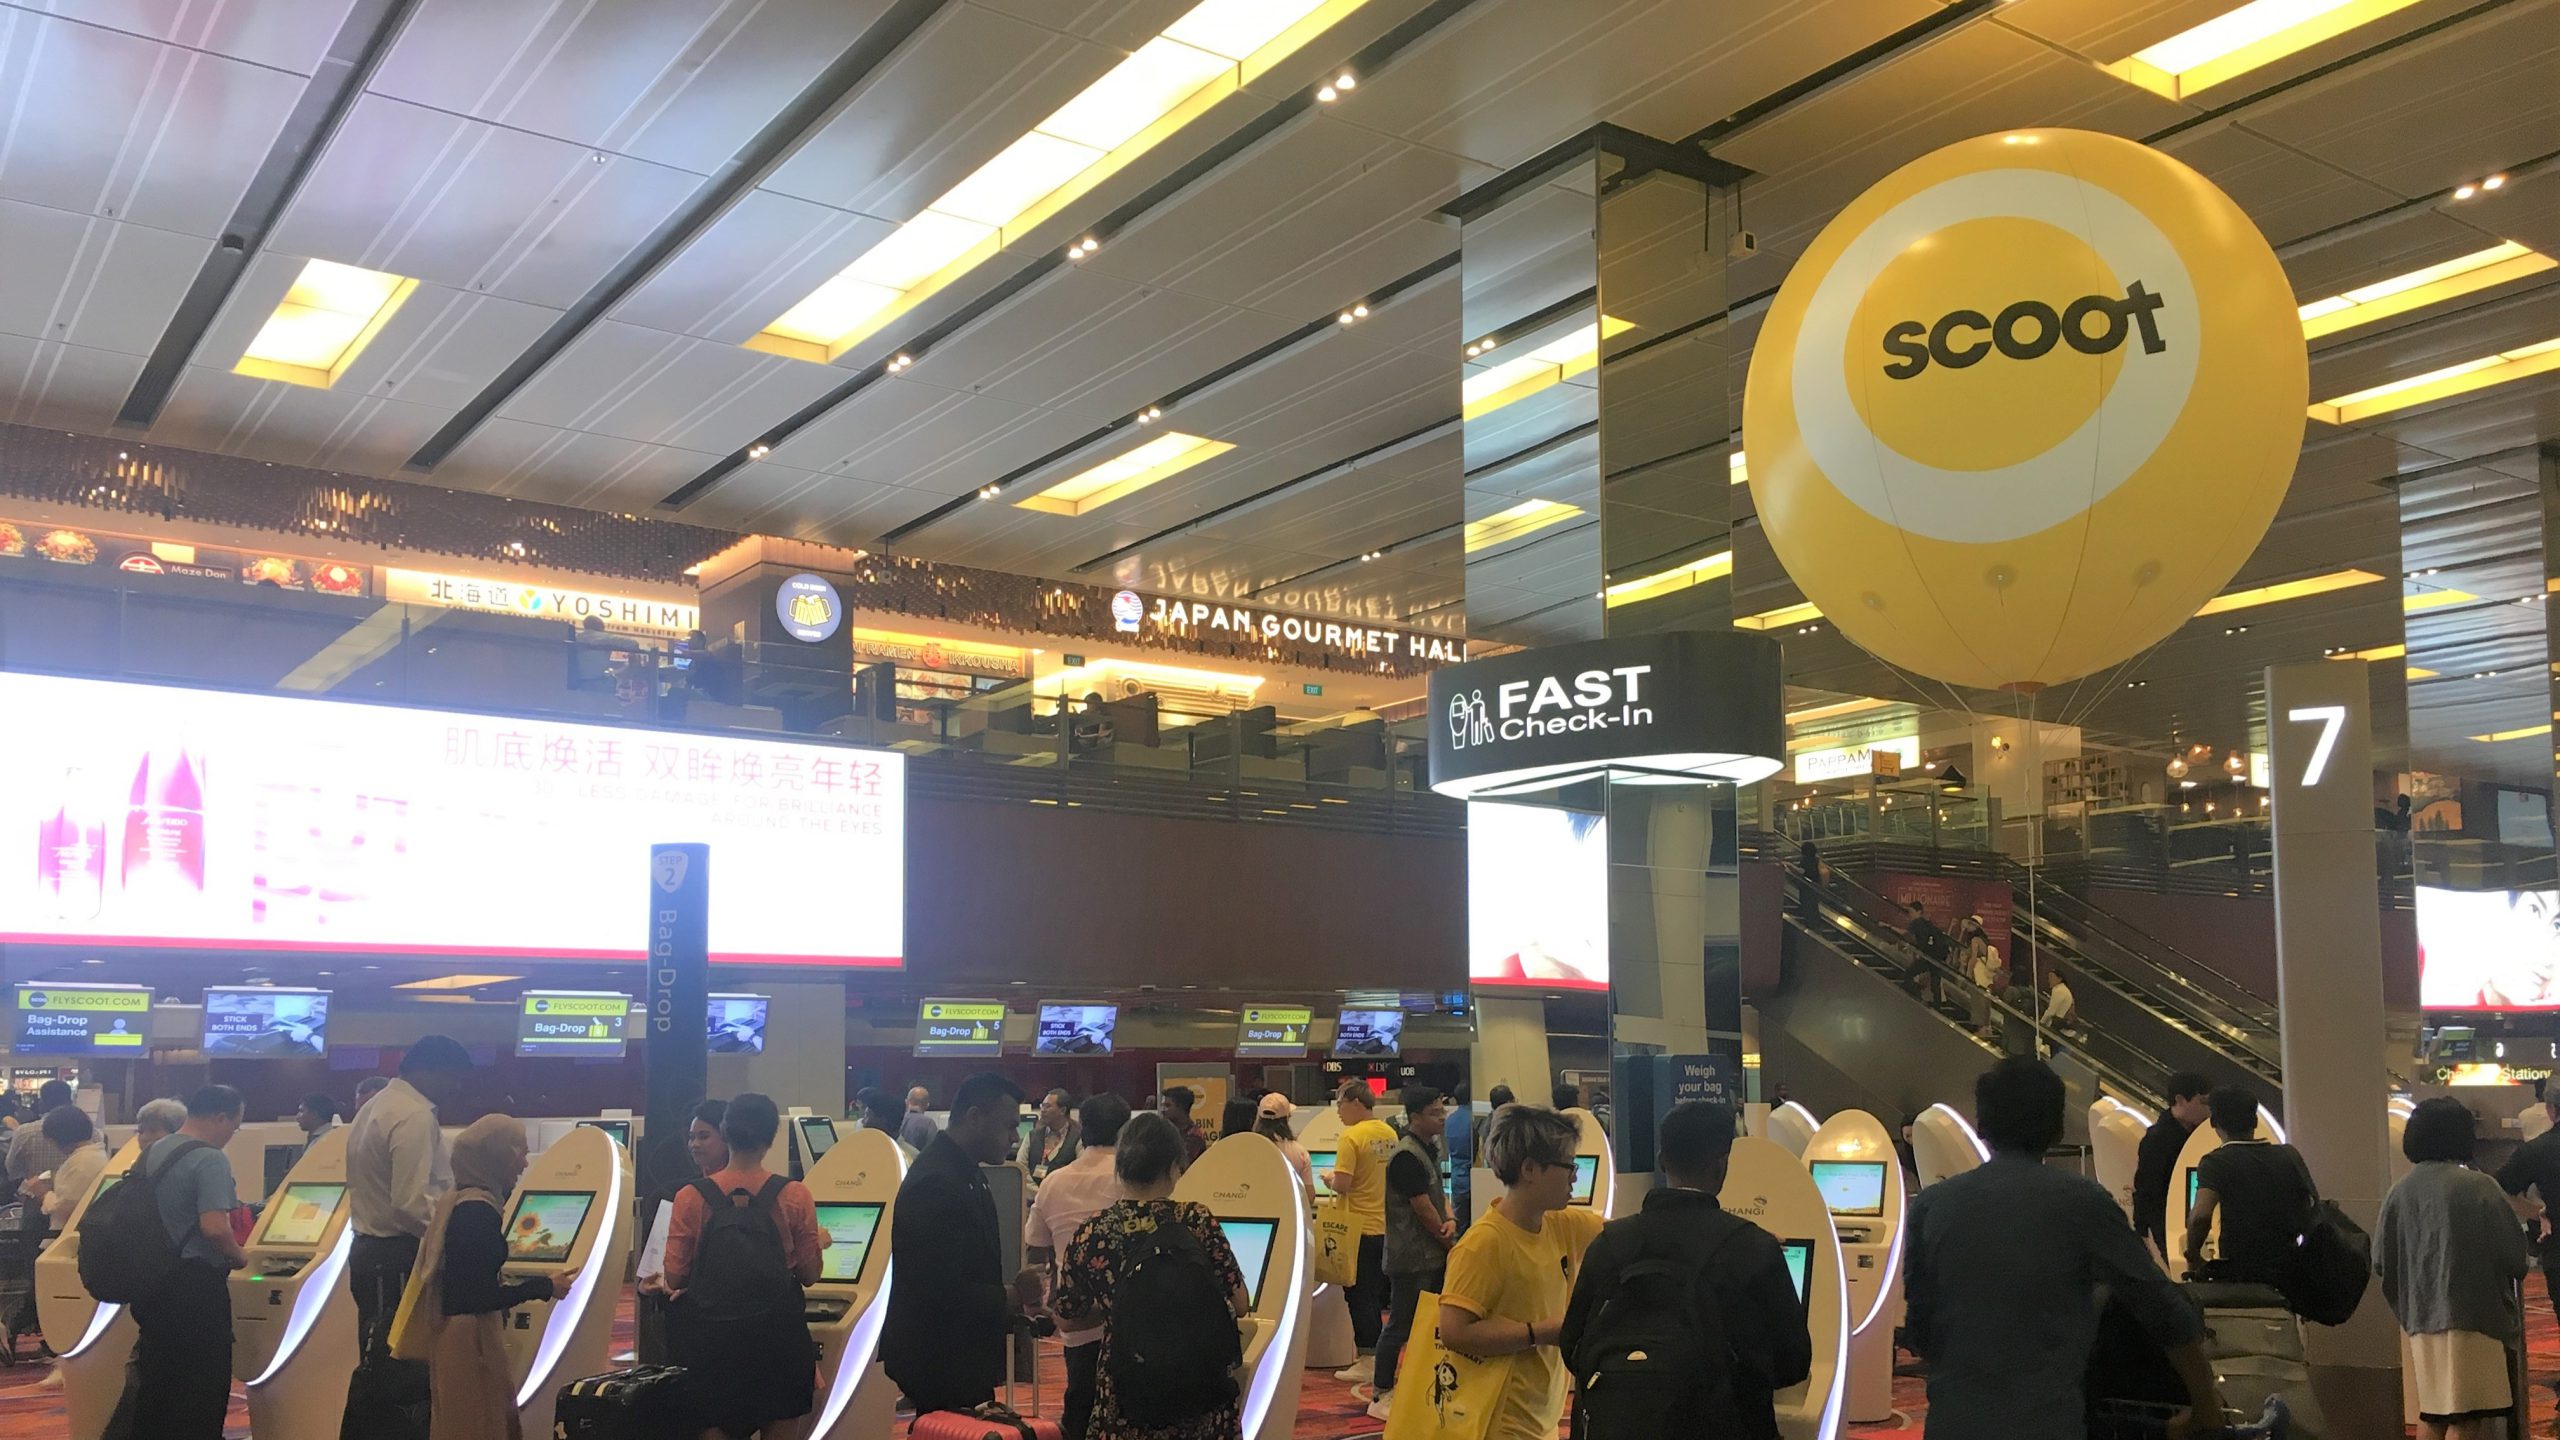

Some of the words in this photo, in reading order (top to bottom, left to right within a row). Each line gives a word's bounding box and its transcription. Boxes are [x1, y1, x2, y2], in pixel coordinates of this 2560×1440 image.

[1882, 279, 2166, 380] scoot
[171, 566, 202, 577] Maze
[205, 569, 226, 579] Don
[431, 579, 509, 607] 北海道
[553, 593, 693, 629] YOSHIMI
[1149, 598, 1251, 633] JAPAN
[1261, 614, 1399, 654] GOURMET
[866, 643, 916, 660] RAMEN
[948, 652, 1019, 672] IKKOUSHA
[1499, 665, 1651, 719] FAST
[1500, 705, 1653, 740] Check-In
[444, 726, 624, 778] 肌底焕活
[2289, 706, 2345, 786] 7
[1808, 749, 1872, 771] PAPPAM
[578, 785, 628, 801] LESS
[733, 795, 771, 811] FOR
[779, 798, 883, 819] BRILLIANCE
[799, 816, 834, 832] THE
[840, 819, 884, 836] EYES
[658, 856, 683, 866] STEP
[664, 868, 676, 886] 2
[654, 910, 678, 1032] Bag-Drop
[52, 996, 141, 1006] FLYSCOOT.COM
[553, 1003, 621, 1011] FLYSCOOT.COM
[223, 1015, 247, 1024] STICK
[945, 1008, 999, 1017] FLYSCOOT.COM
[27, 1015, 88, 1026] Bag-Drop
[212, 1024, 233, 1032] BOTH
[236, 1024, 258, 1032] ENDS
[534, 1023, 586, 1034] Bag-Drop
[615, 1017, 622, 1027] 3
[27, 1027, 88, 1036] Assistance
[930, 1027, 971, 1037] Bag-Drop
[994, 1021, 1000, 1030] 5
[1248, 1030, 1282, 1040] Bag-Drop
[1301, 1025, 1307, 1033] 7
[1326, 1062, 1342, 1071] DBS
[1400, 1066, 1415, 1077] UOB
[1684, 1064, 1716, 1078] Weigh
[1678, 1082, 1701, 1094] your
[1704, 1080, 1722, 1093] bag
[1197, 1118, 1214, 1129] BIN
[1212, 1191, 1247, 1199] CHANGI
[1323, 1222, 1349, 1232] ESCAPE
